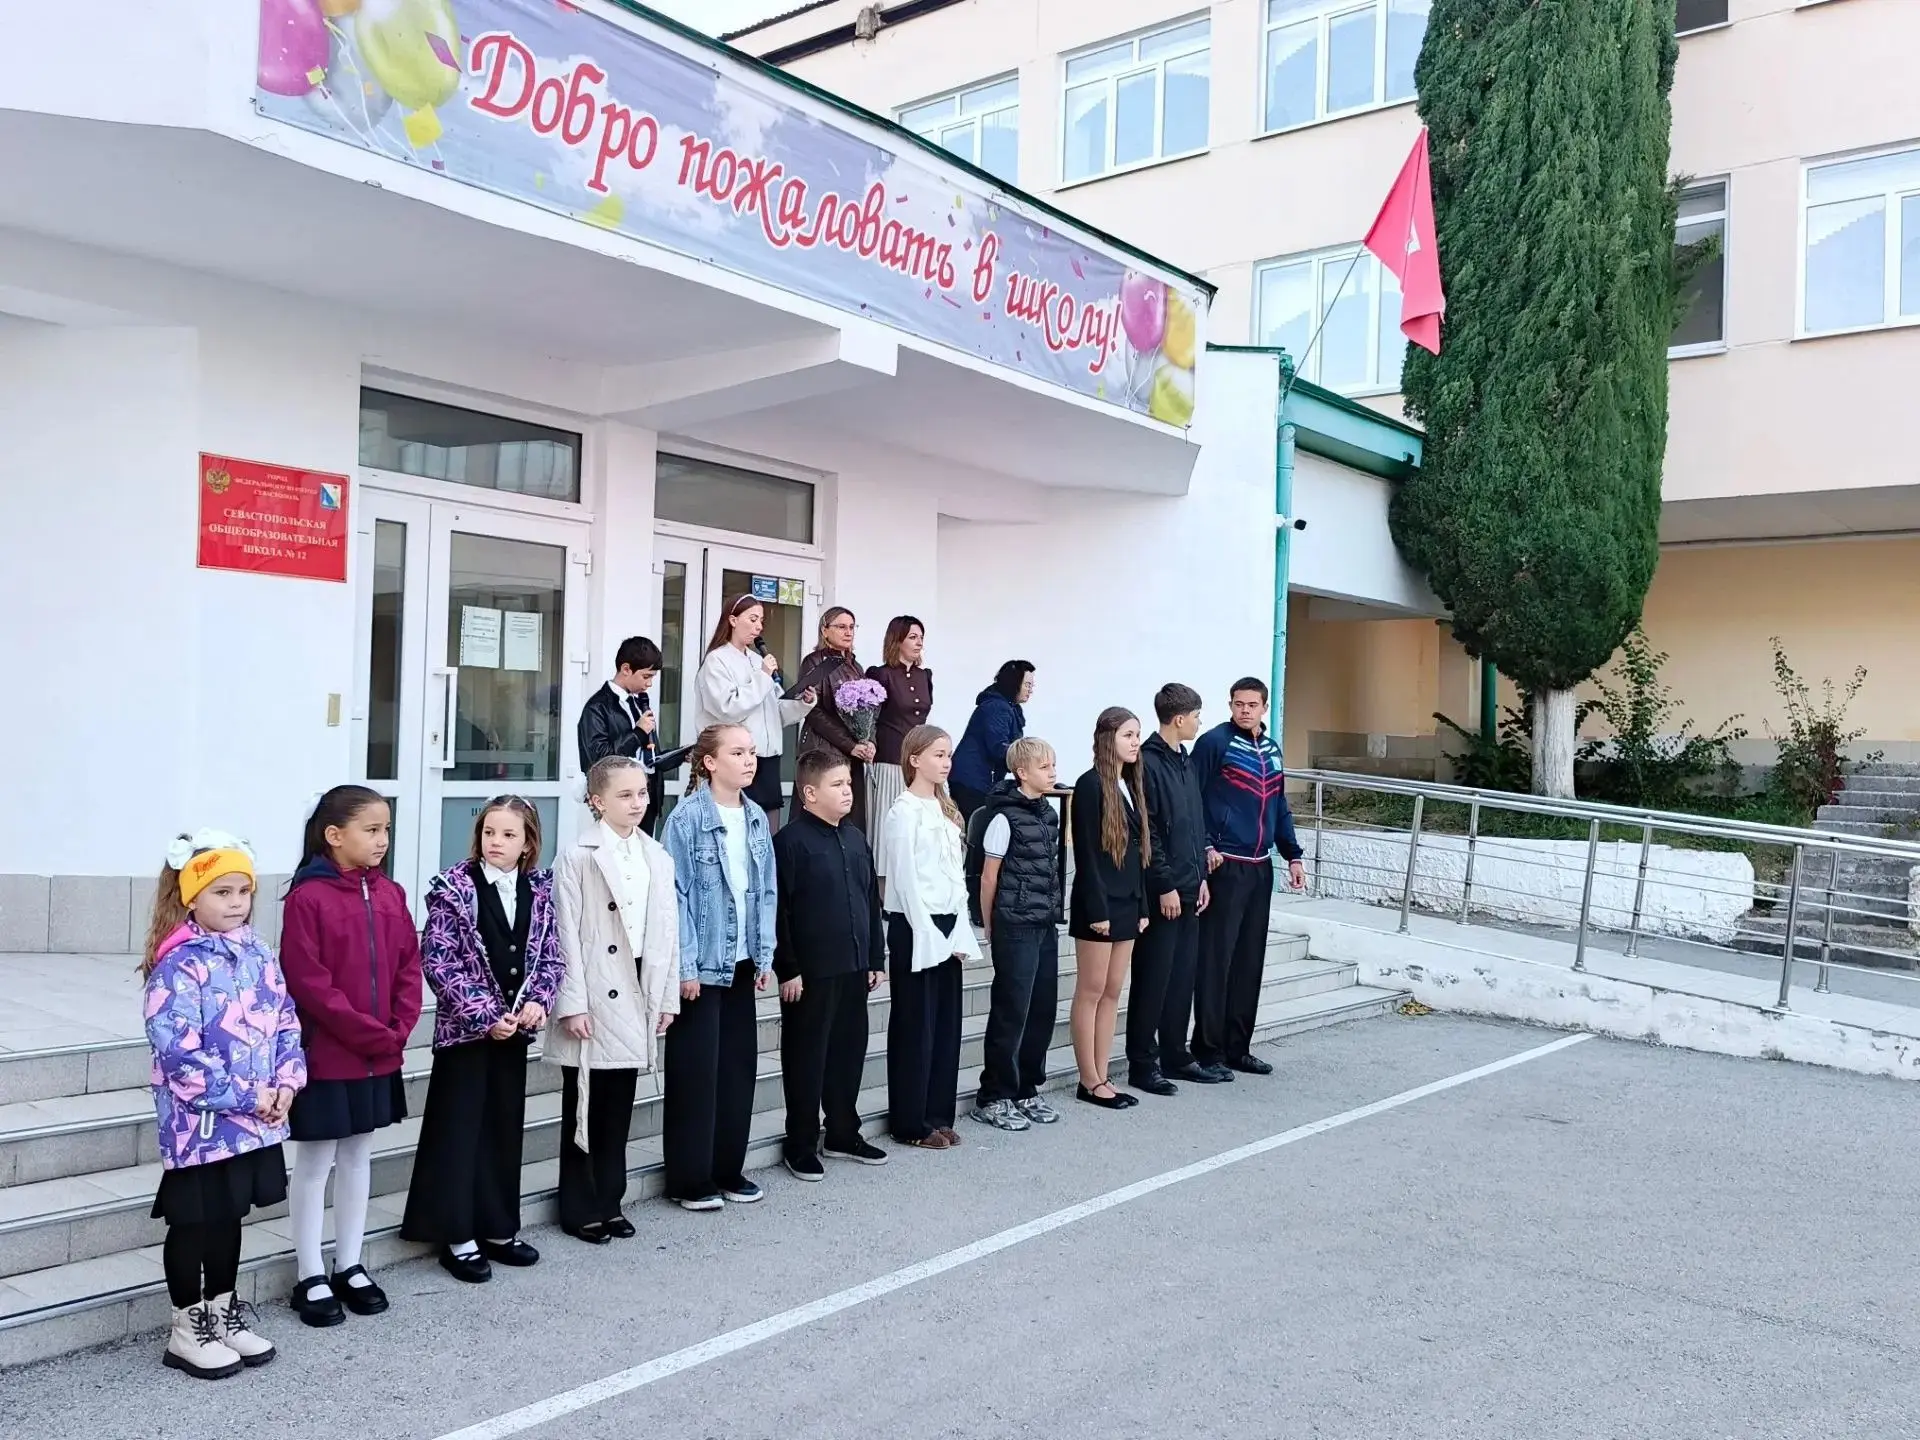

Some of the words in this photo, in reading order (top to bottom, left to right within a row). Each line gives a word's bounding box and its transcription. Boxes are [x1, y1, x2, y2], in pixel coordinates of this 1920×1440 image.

[469, 33, 658, 193] Добро
[677, 133, 955, 288] пожаловать
[973, 233, 997, 301] в
[1006, 271, 1123, 373] школу!
[223, 508, 327, 530] СЕВАСТОПОЛЬСКАЯ
[209, 523, 339, 548] ОБЩЕОБРАЗОВАТЕЛЬНАЯ
[243, 544, 283, 557] ШКОЛА
[297, 551, 307, 560] 12
